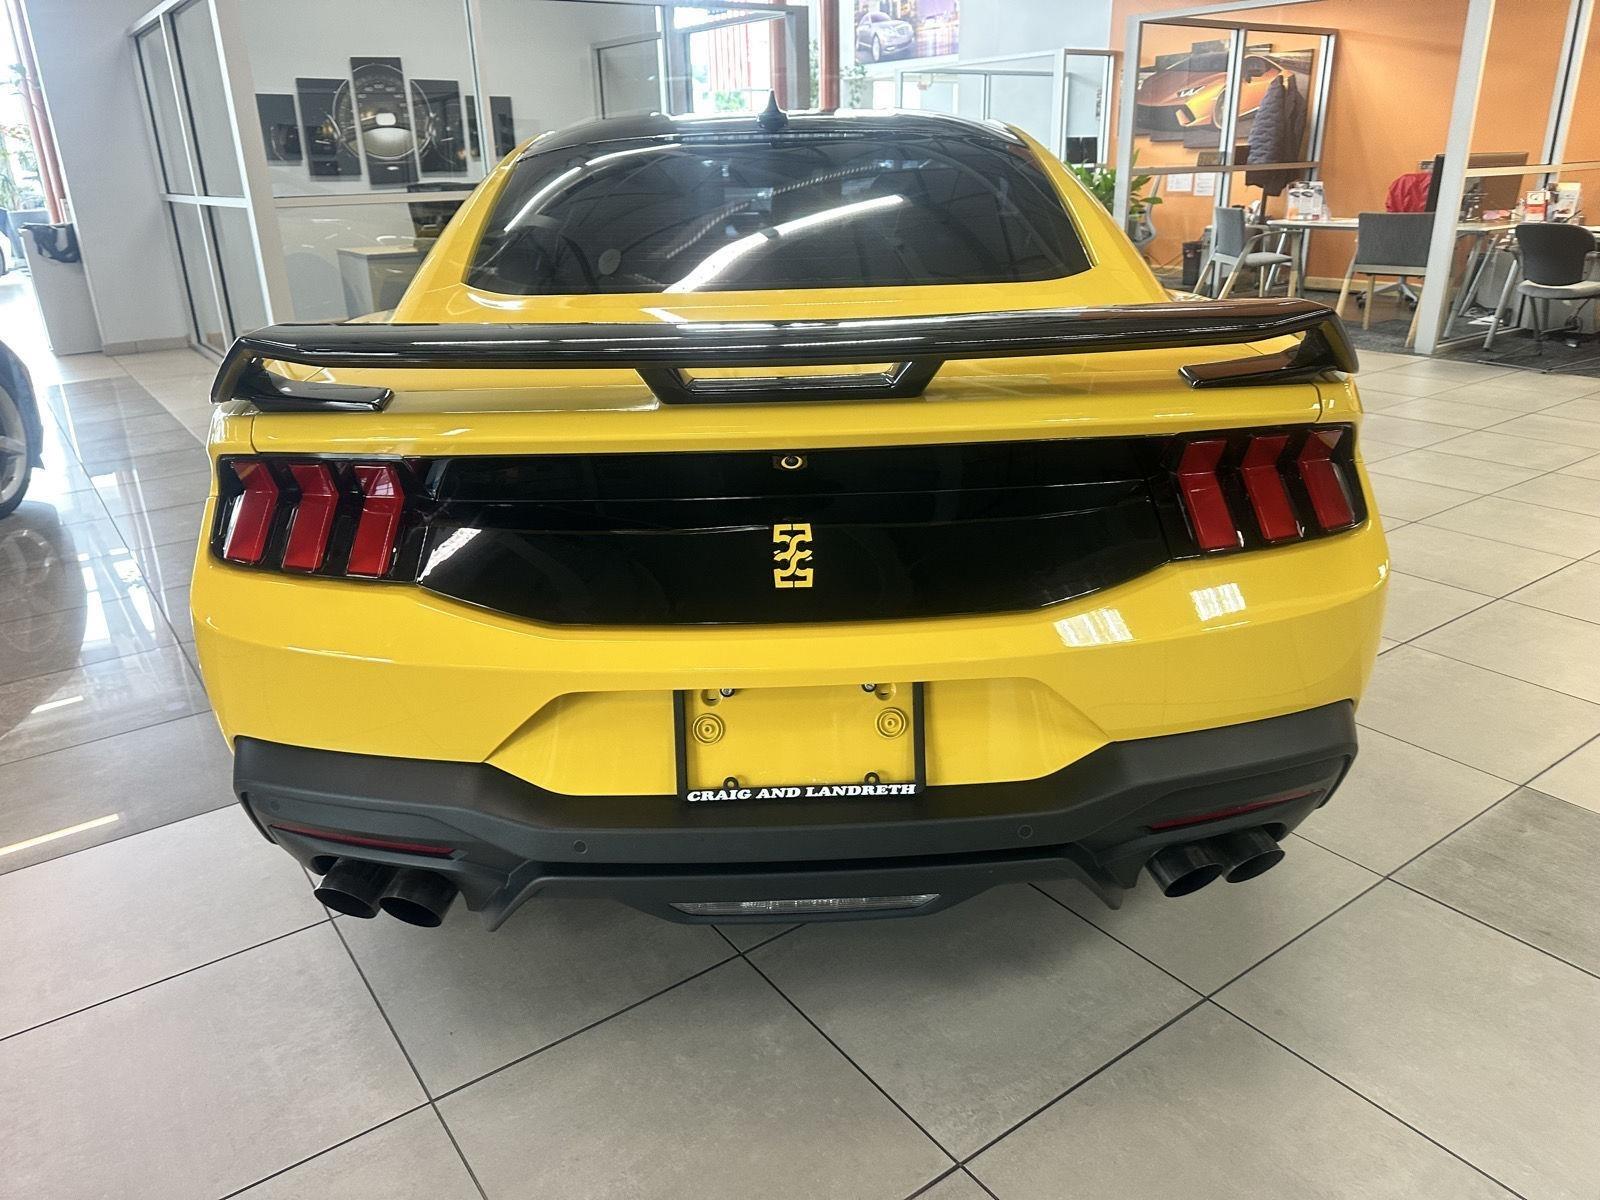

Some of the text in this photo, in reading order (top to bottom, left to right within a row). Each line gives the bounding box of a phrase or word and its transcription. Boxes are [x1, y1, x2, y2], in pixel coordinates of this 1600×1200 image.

[687, 784, 917, 801] CRAIG AND LANDRETH
